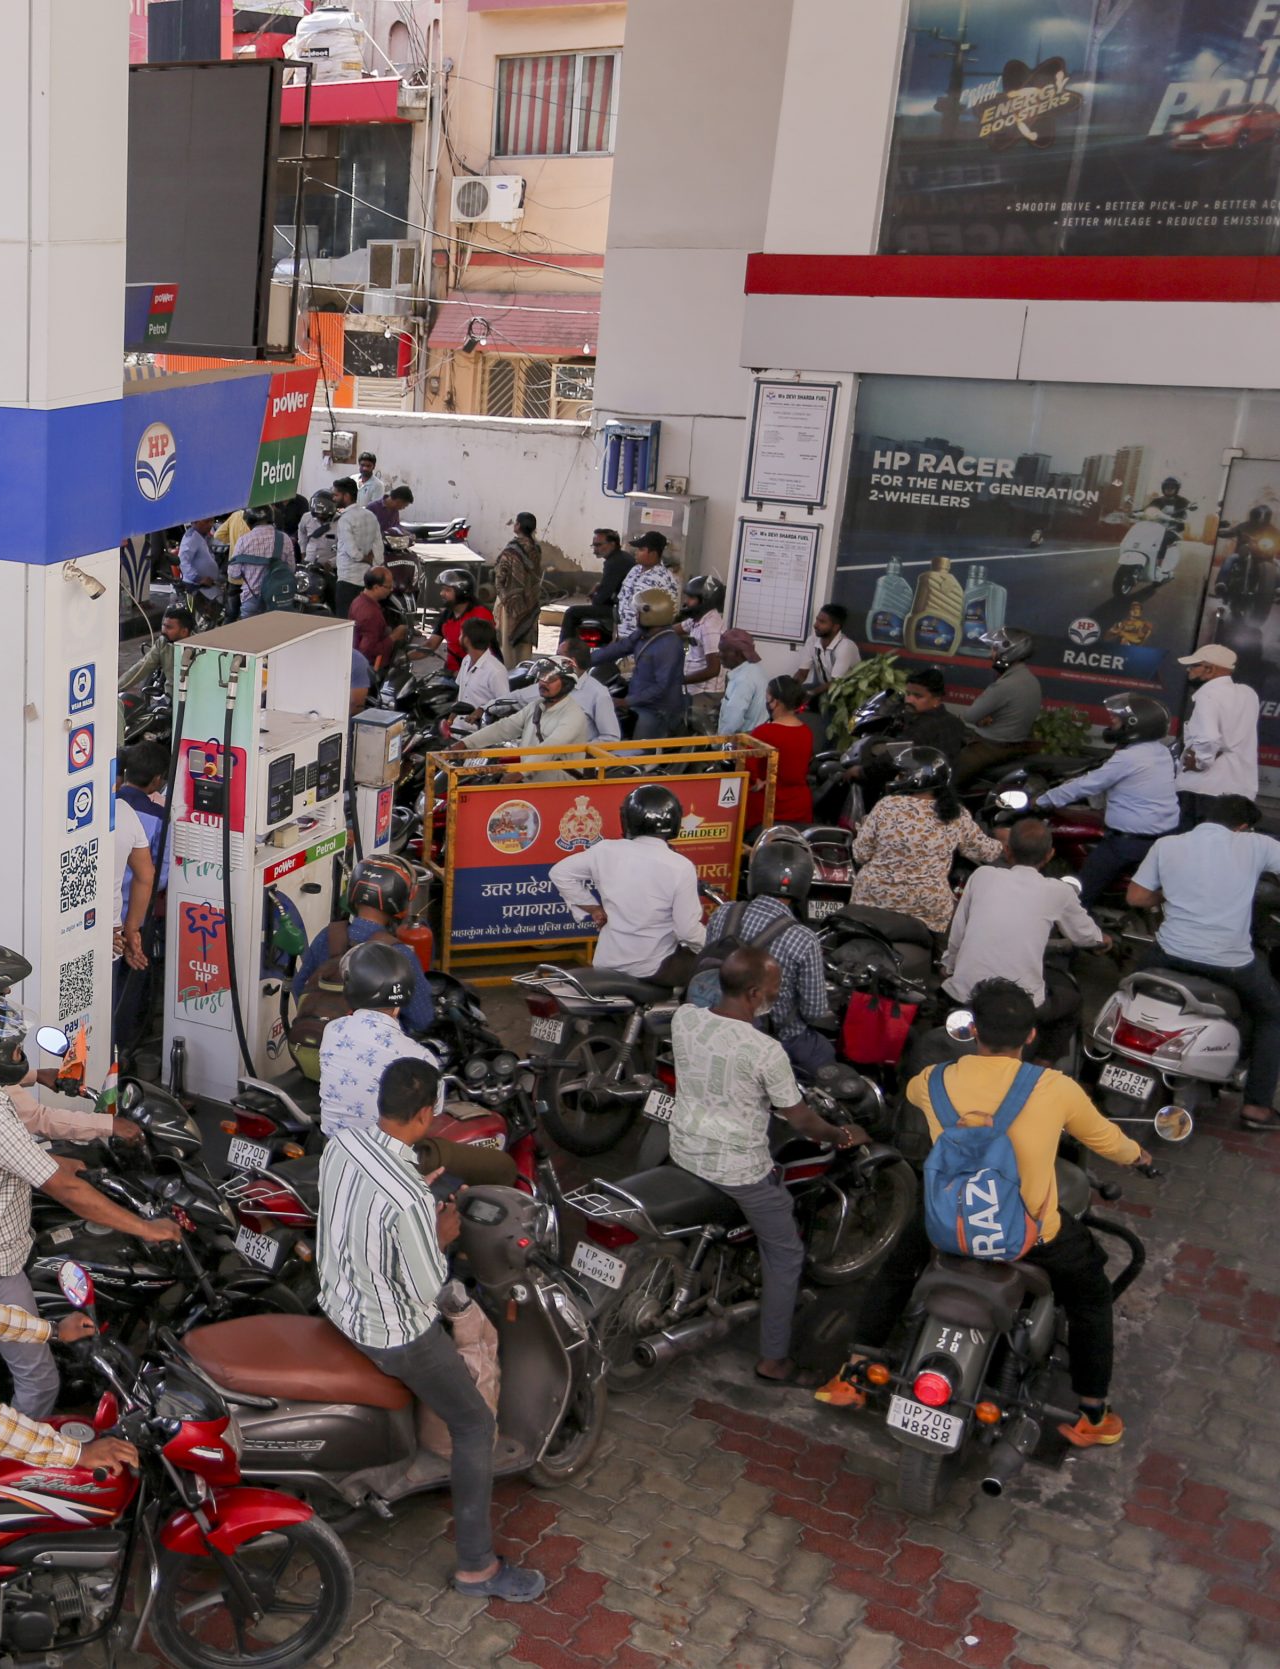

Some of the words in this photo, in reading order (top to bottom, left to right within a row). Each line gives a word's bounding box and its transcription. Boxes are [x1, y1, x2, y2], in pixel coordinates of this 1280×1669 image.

[980, 77, 1070, 124] ENERGY
[978, 92, 1070, 138] BOOSTERS
[1015, 202, 1056, 212] SMOOTH
[1061, 202, 1091, 212] DRIVE
[1105, 201, 1145, 211] BETTER
[1150, 200, 1198, 211] PICK-UP
[1214, 199, 1256, 210] BETTER
[1061, 216, 1099, 227] BETTER
[1104, 216, 1151, 226] MILEAGE
[1166, 215, 1218, 226] REDUCED
[148, 322, 167, 336] Petrol
[148, 433, 169, 459] HP
[260, 455, 297, 487] Petrol
[873, 450, 911, 471] HP
[917, 453, 1016, 479] RACER
[869, 489, 971, 509] 2-WHEELERS
[871, 474, 902, 487] FOR
[907, 476, 937, 489] THE
[941, 479, 986, 494] NEXT
[989, 482, 1100, 503] GENERATION
[1077, 621, 1095, 631] HP
[1063, 649, 1125, 671] RACER
[315, 838, 336, 857] Petrol
[481, 880, 513, 897] उत्तर
[515, 875, 553, 896] प्रदेश
[501, 922, 513, 935] के
[538, 921, 562, 935] पुलिस
[563, 920, 576, 931] का
[189, 959, 219, 975] CLUB
[194, 971, 212, 983] HP
[179, 985, 230, 1016] First
[237, 1141, 266, 1161] UP70D
[245, 1229, 273, 1253] UP42K
[244, 1243, 266, 1264] 8194
[903, 1401, 952, 1432] UP70G
[900, 1416, 951, 1445] W8858
